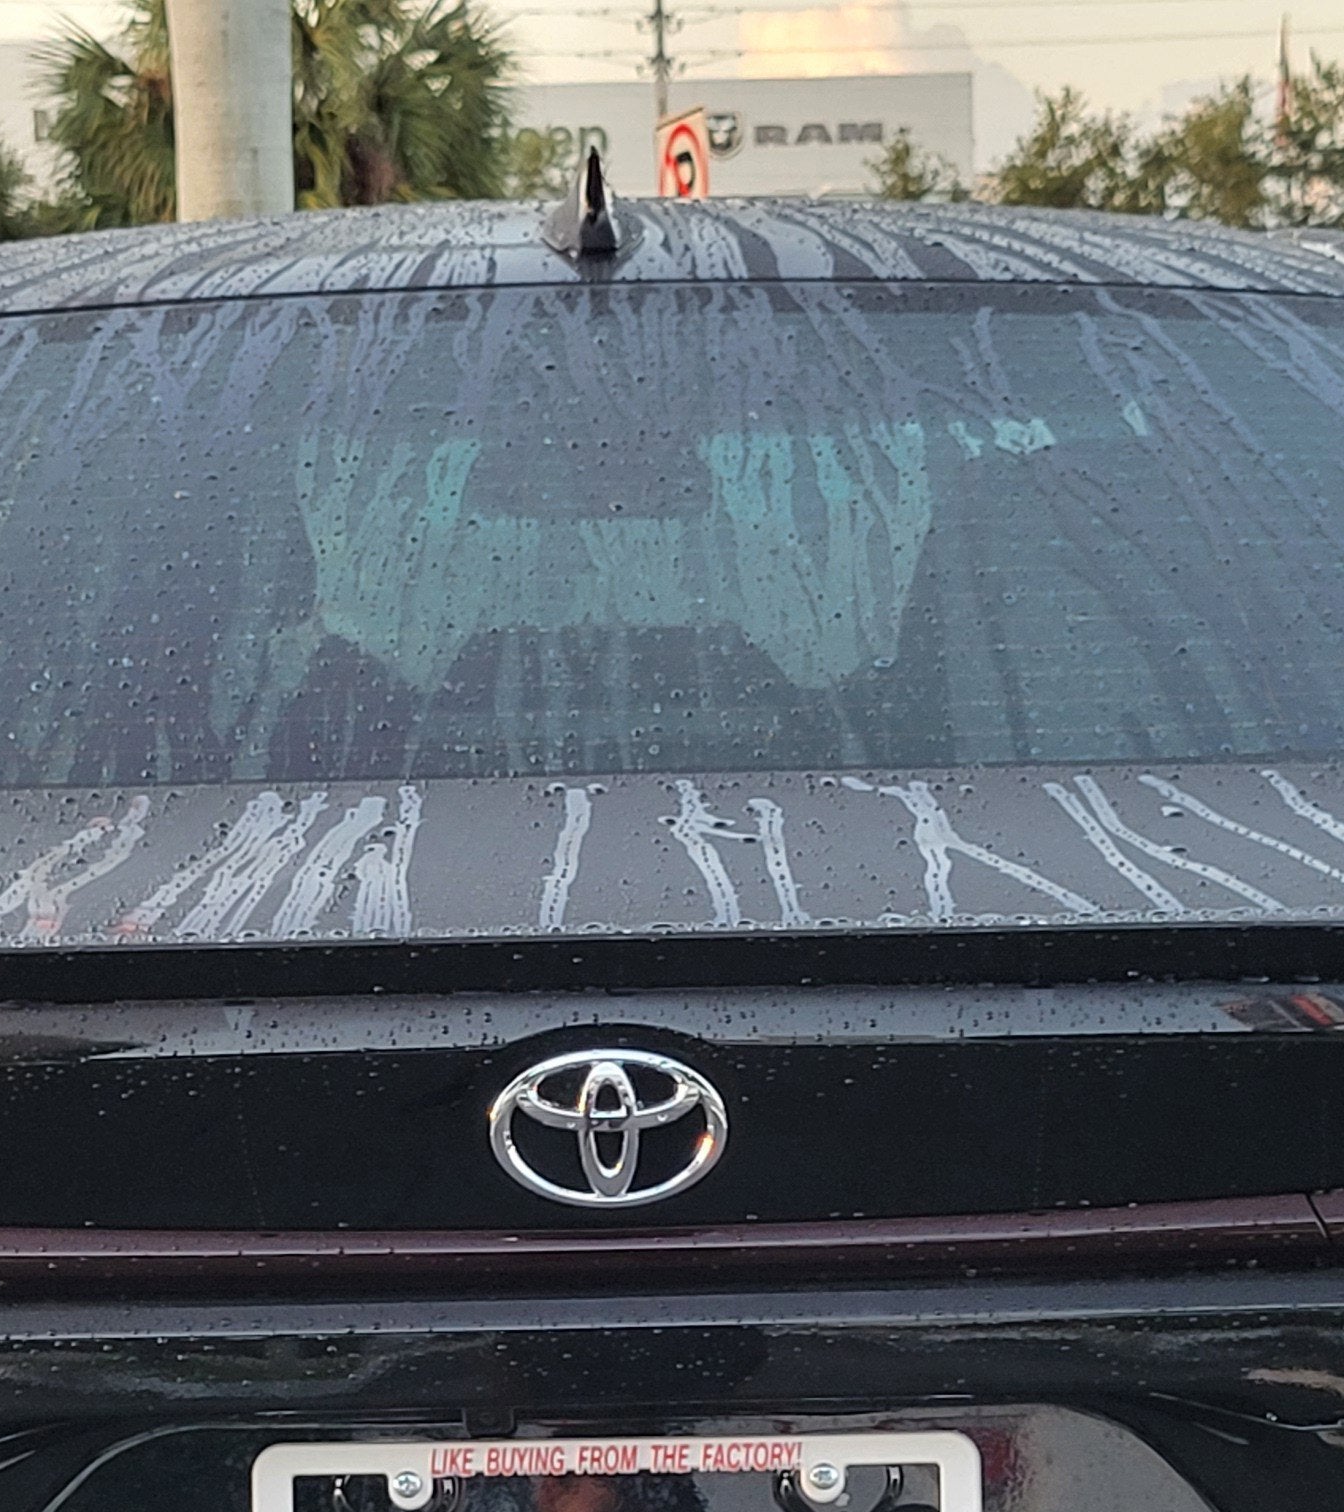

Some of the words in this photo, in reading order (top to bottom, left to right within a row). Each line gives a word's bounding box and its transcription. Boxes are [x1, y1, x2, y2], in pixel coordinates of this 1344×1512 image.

[754, 123, 884, 145] RAM
[496, 126, 608, 181] eep
[430, 1448, 475, 1476] LIKE
[486, 1447, 565, 1474] BUYING
[578, 1446, 637, 1473] FROM
[651, 1444, 690, 1471] THE
[702, 1442, 803, 1470] FACTORY!
